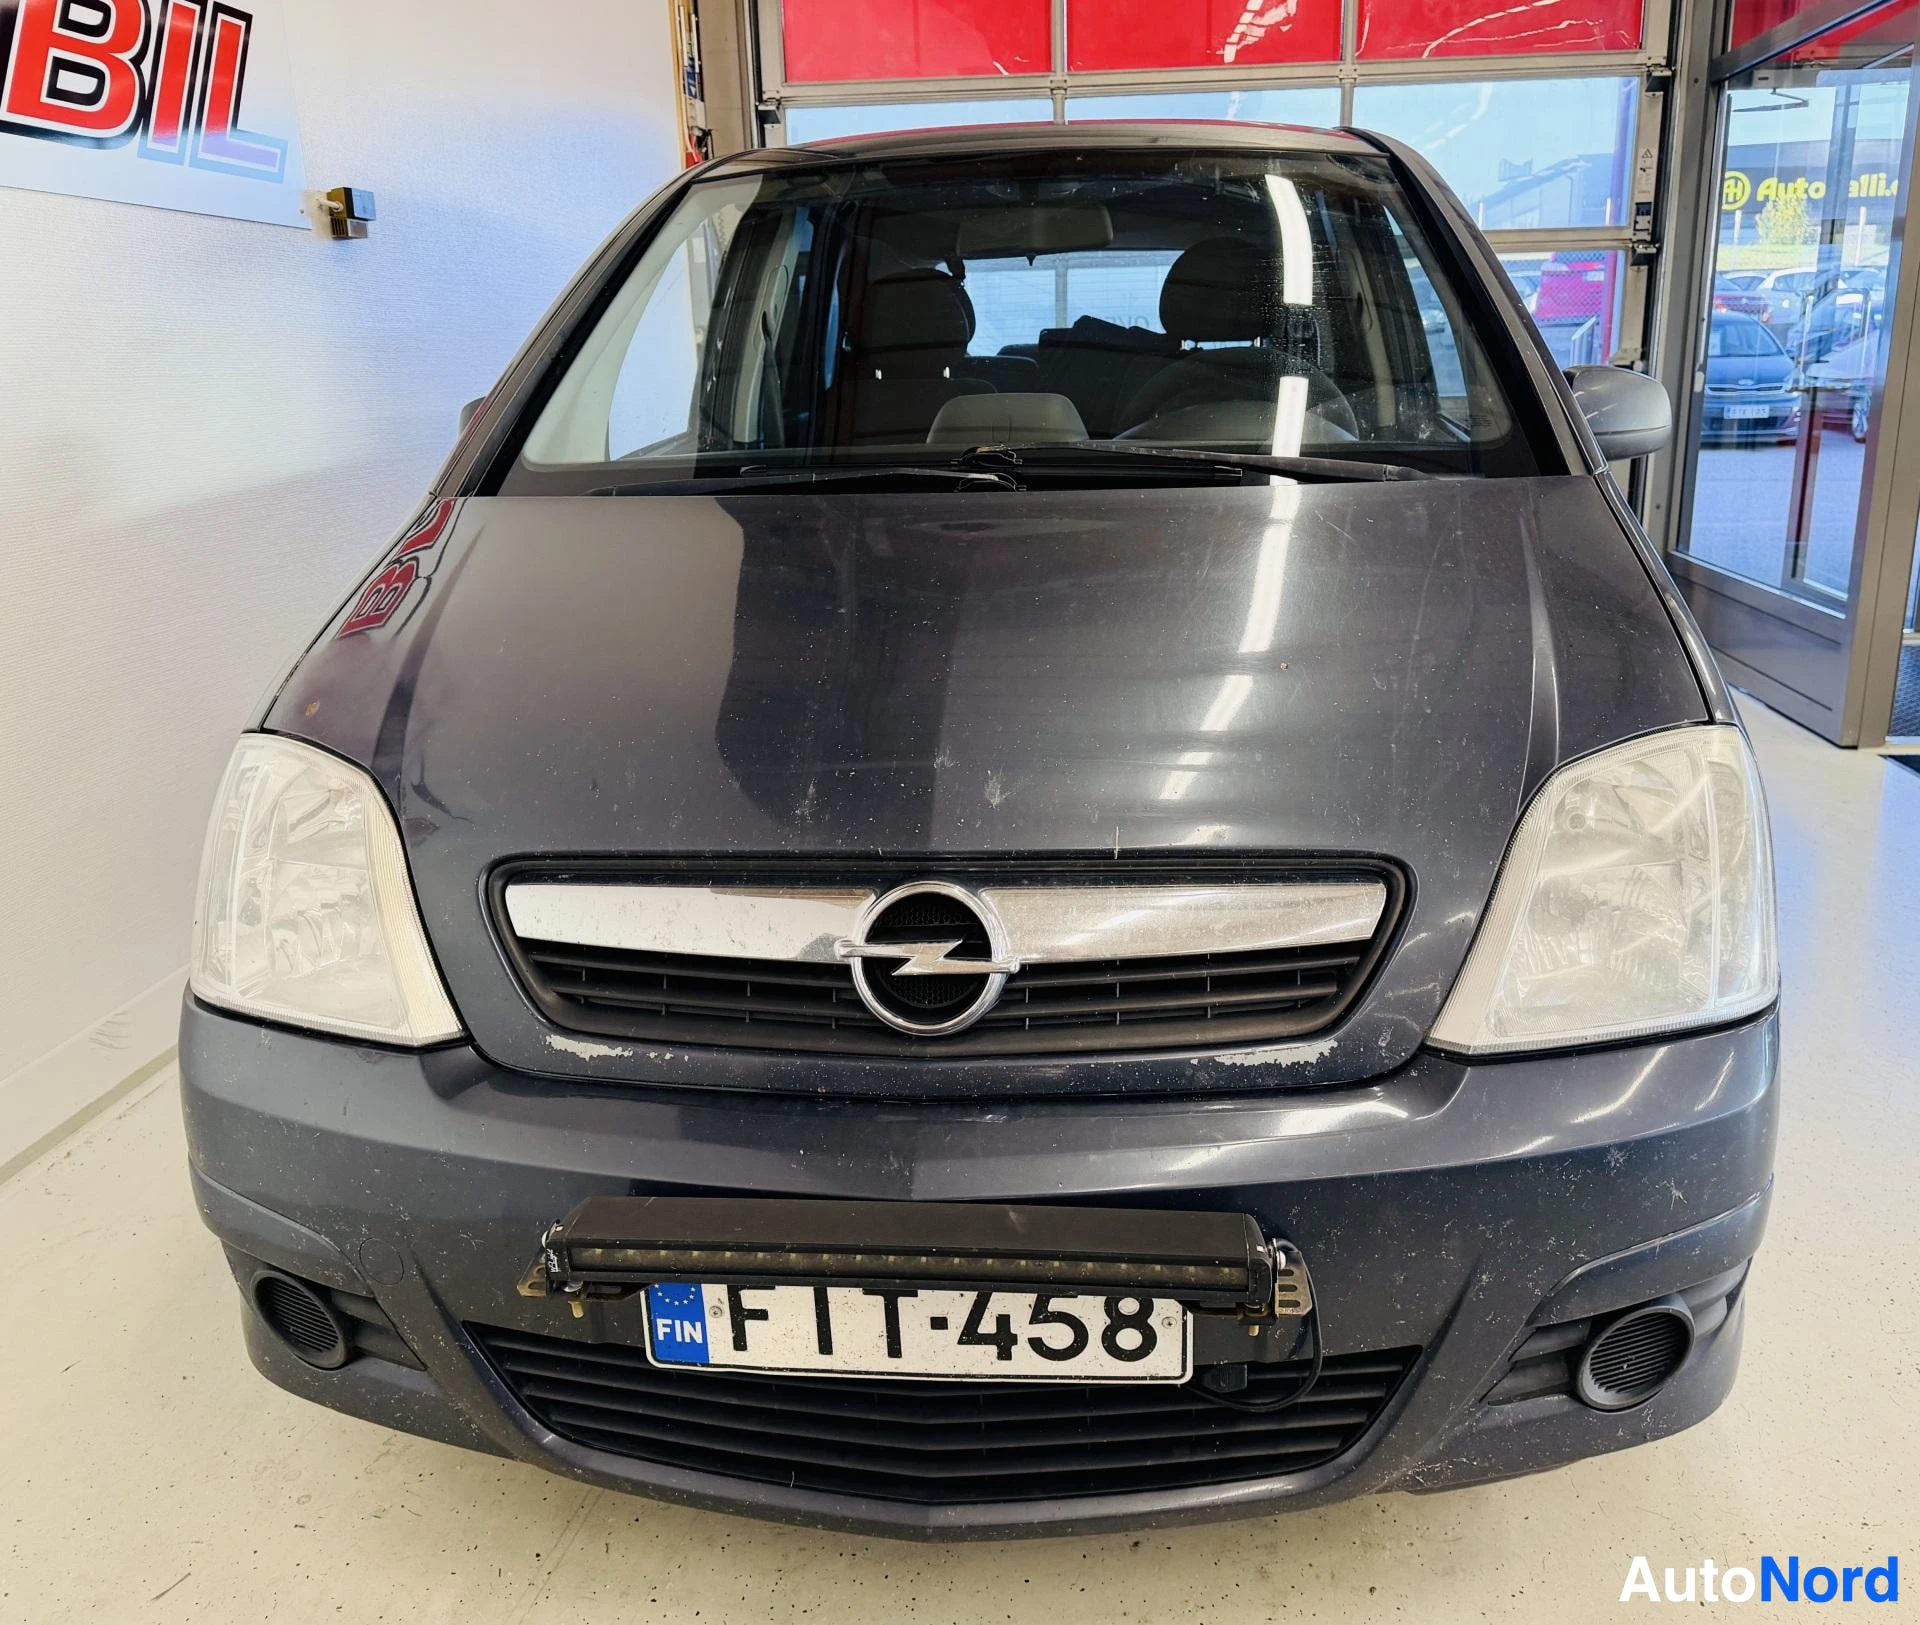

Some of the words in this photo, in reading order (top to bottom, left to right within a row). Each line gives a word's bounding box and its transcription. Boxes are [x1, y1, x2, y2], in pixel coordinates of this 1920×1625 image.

[0, 0, 288, 184] BIL
[656, 1318, 703, 1344] FIN
[727, 1284, 1158, 1362] FIT-458
